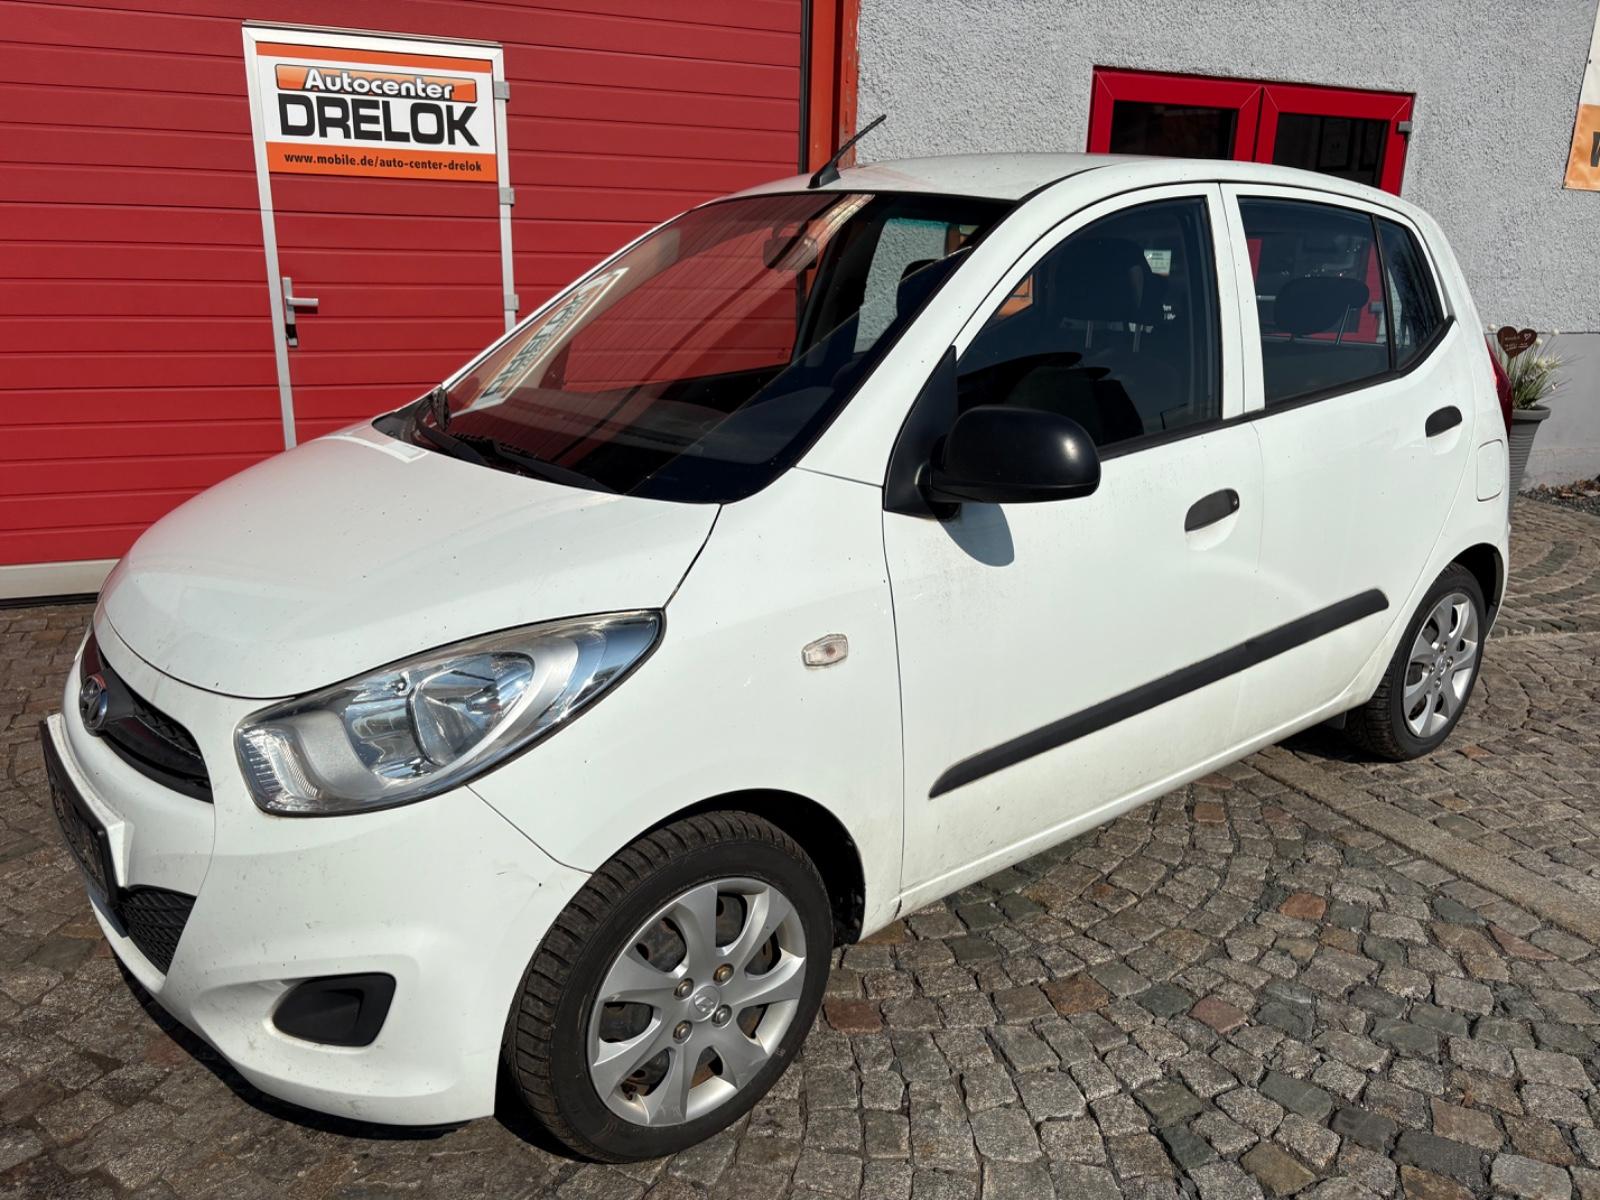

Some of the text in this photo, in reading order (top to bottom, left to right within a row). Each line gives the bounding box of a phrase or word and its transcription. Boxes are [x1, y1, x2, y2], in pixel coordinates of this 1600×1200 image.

[304, 67, 453, 100] Autocenter
[278, 93, 480, 147] DRELOK
[284, 152, 482, 172] www.mobile.de/auto-center-drelok
